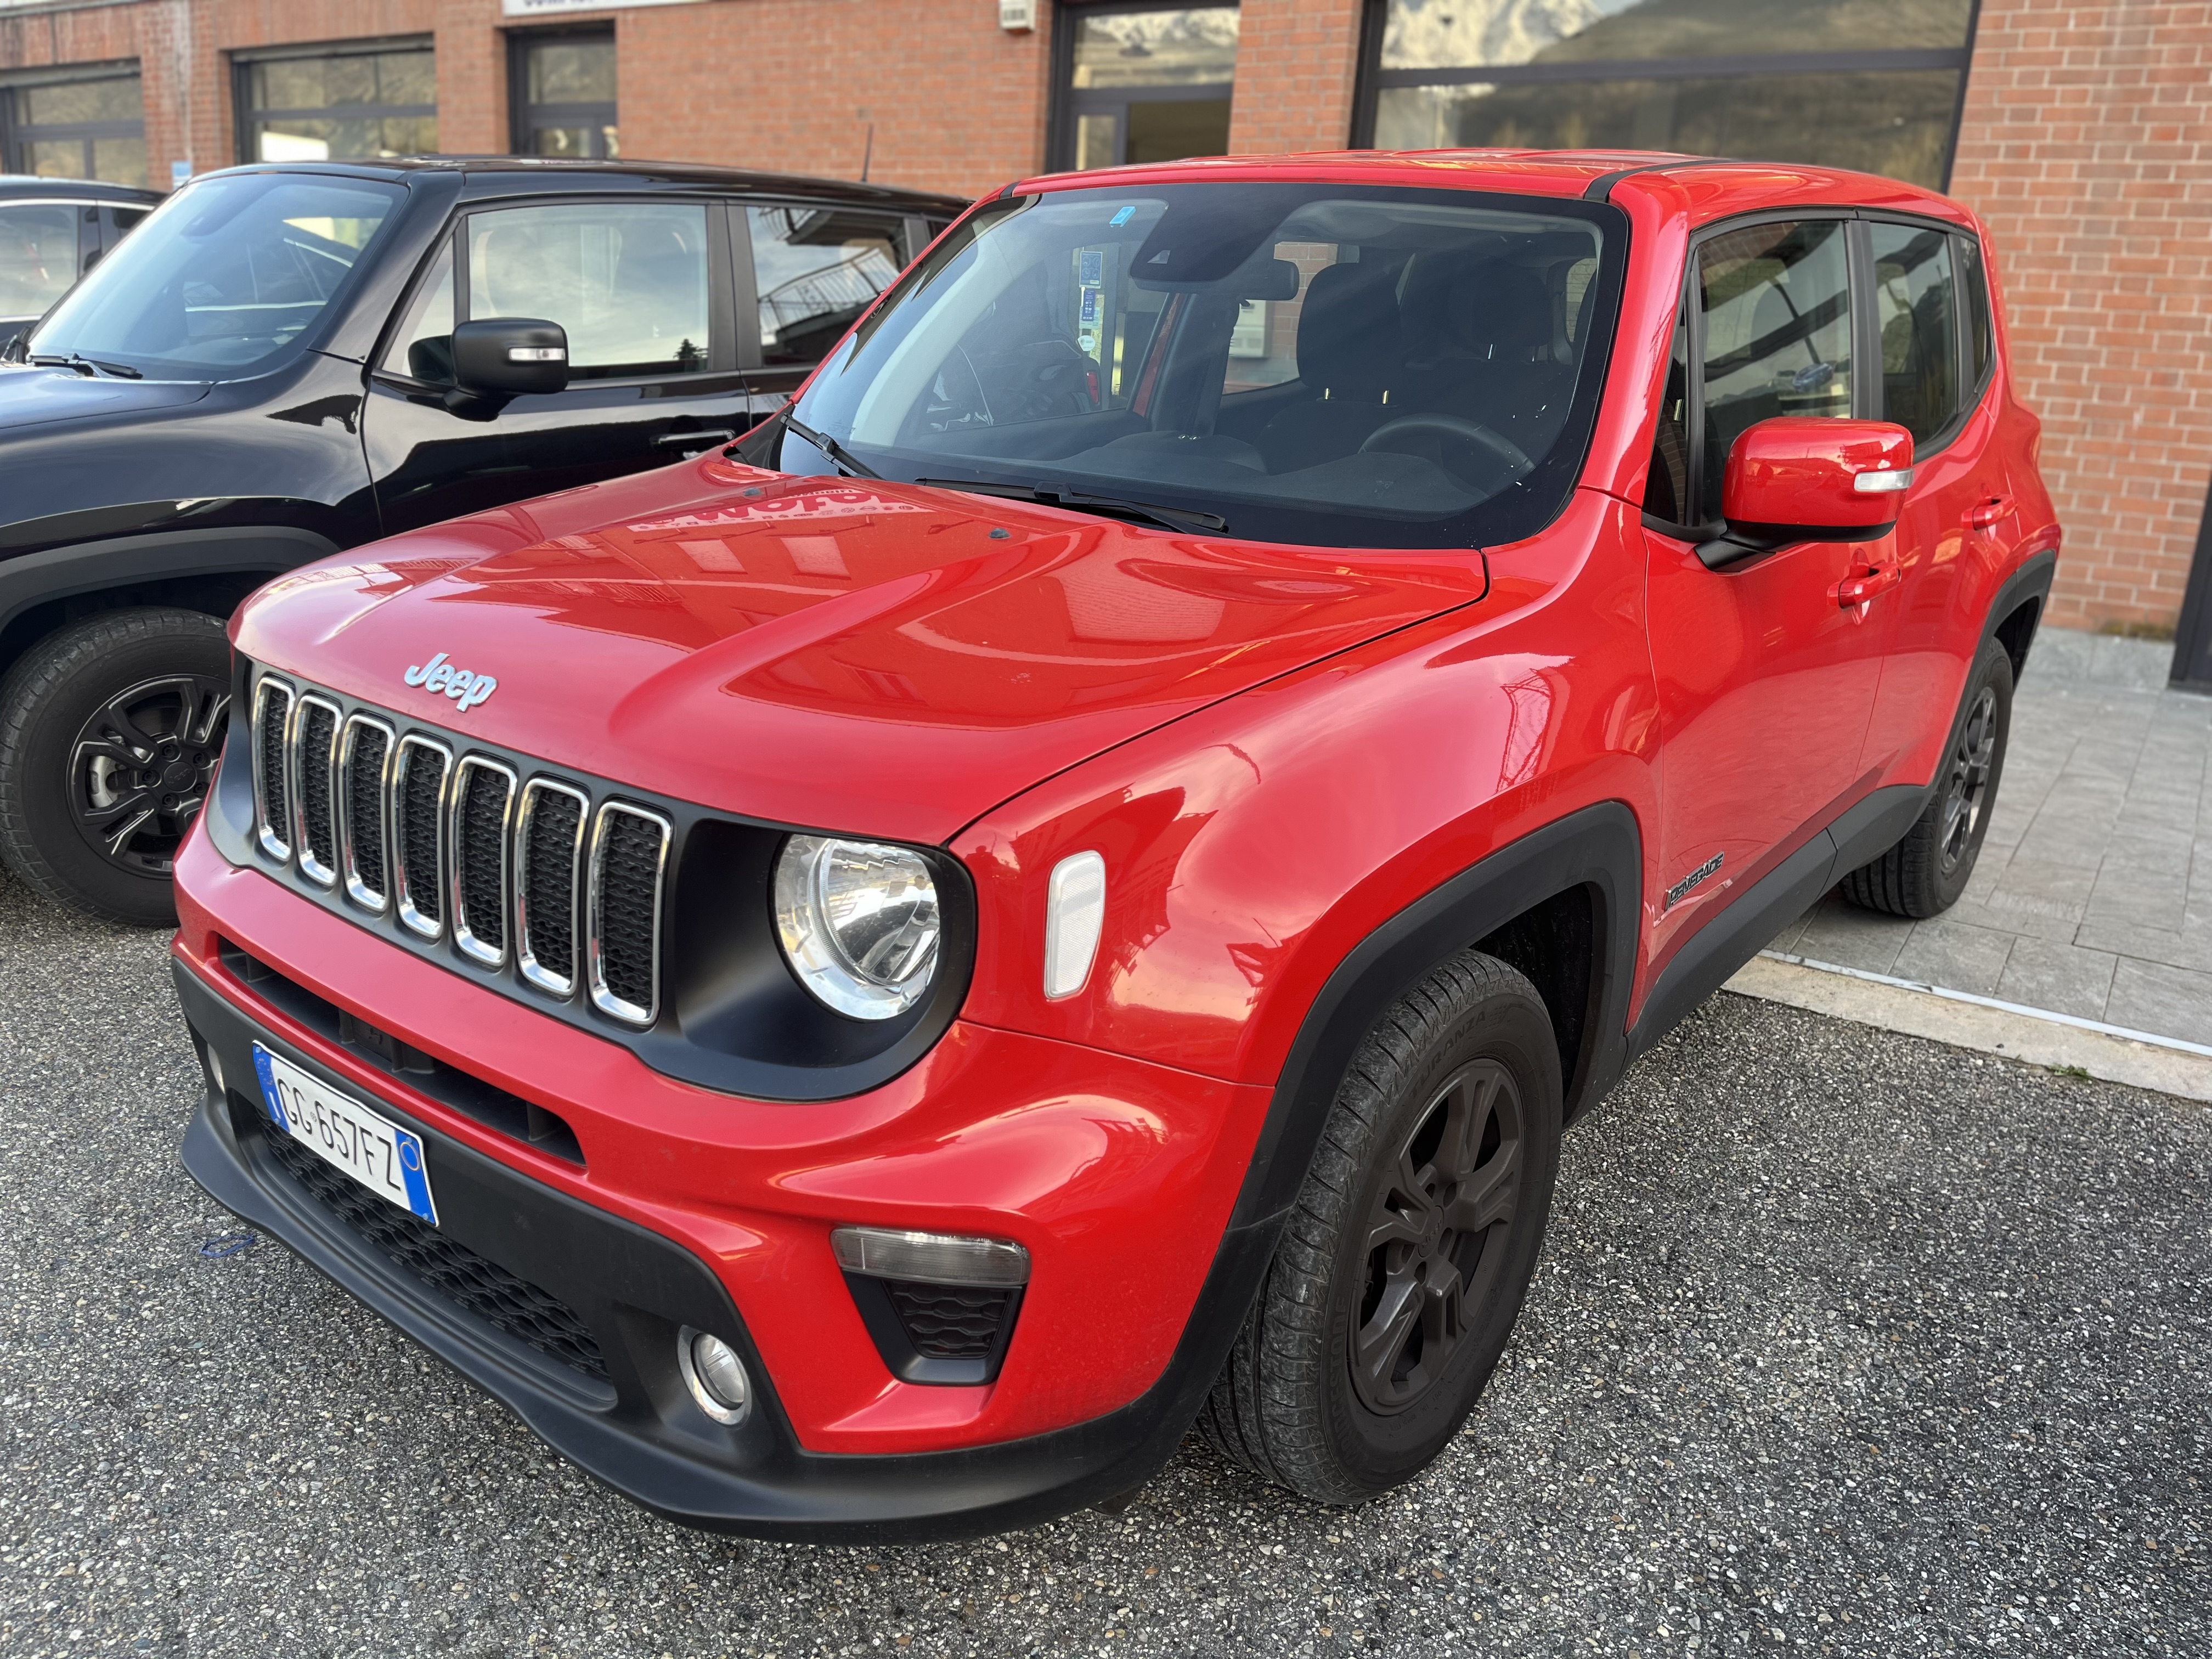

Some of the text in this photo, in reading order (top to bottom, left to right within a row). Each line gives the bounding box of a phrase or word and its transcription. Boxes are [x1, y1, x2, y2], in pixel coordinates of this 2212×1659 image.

[404, 652, 498, 713] Jeep
[1667, 852, 1724, 908] RENEGADE
[1409, 1011, 1486, 1098] TURANZA
